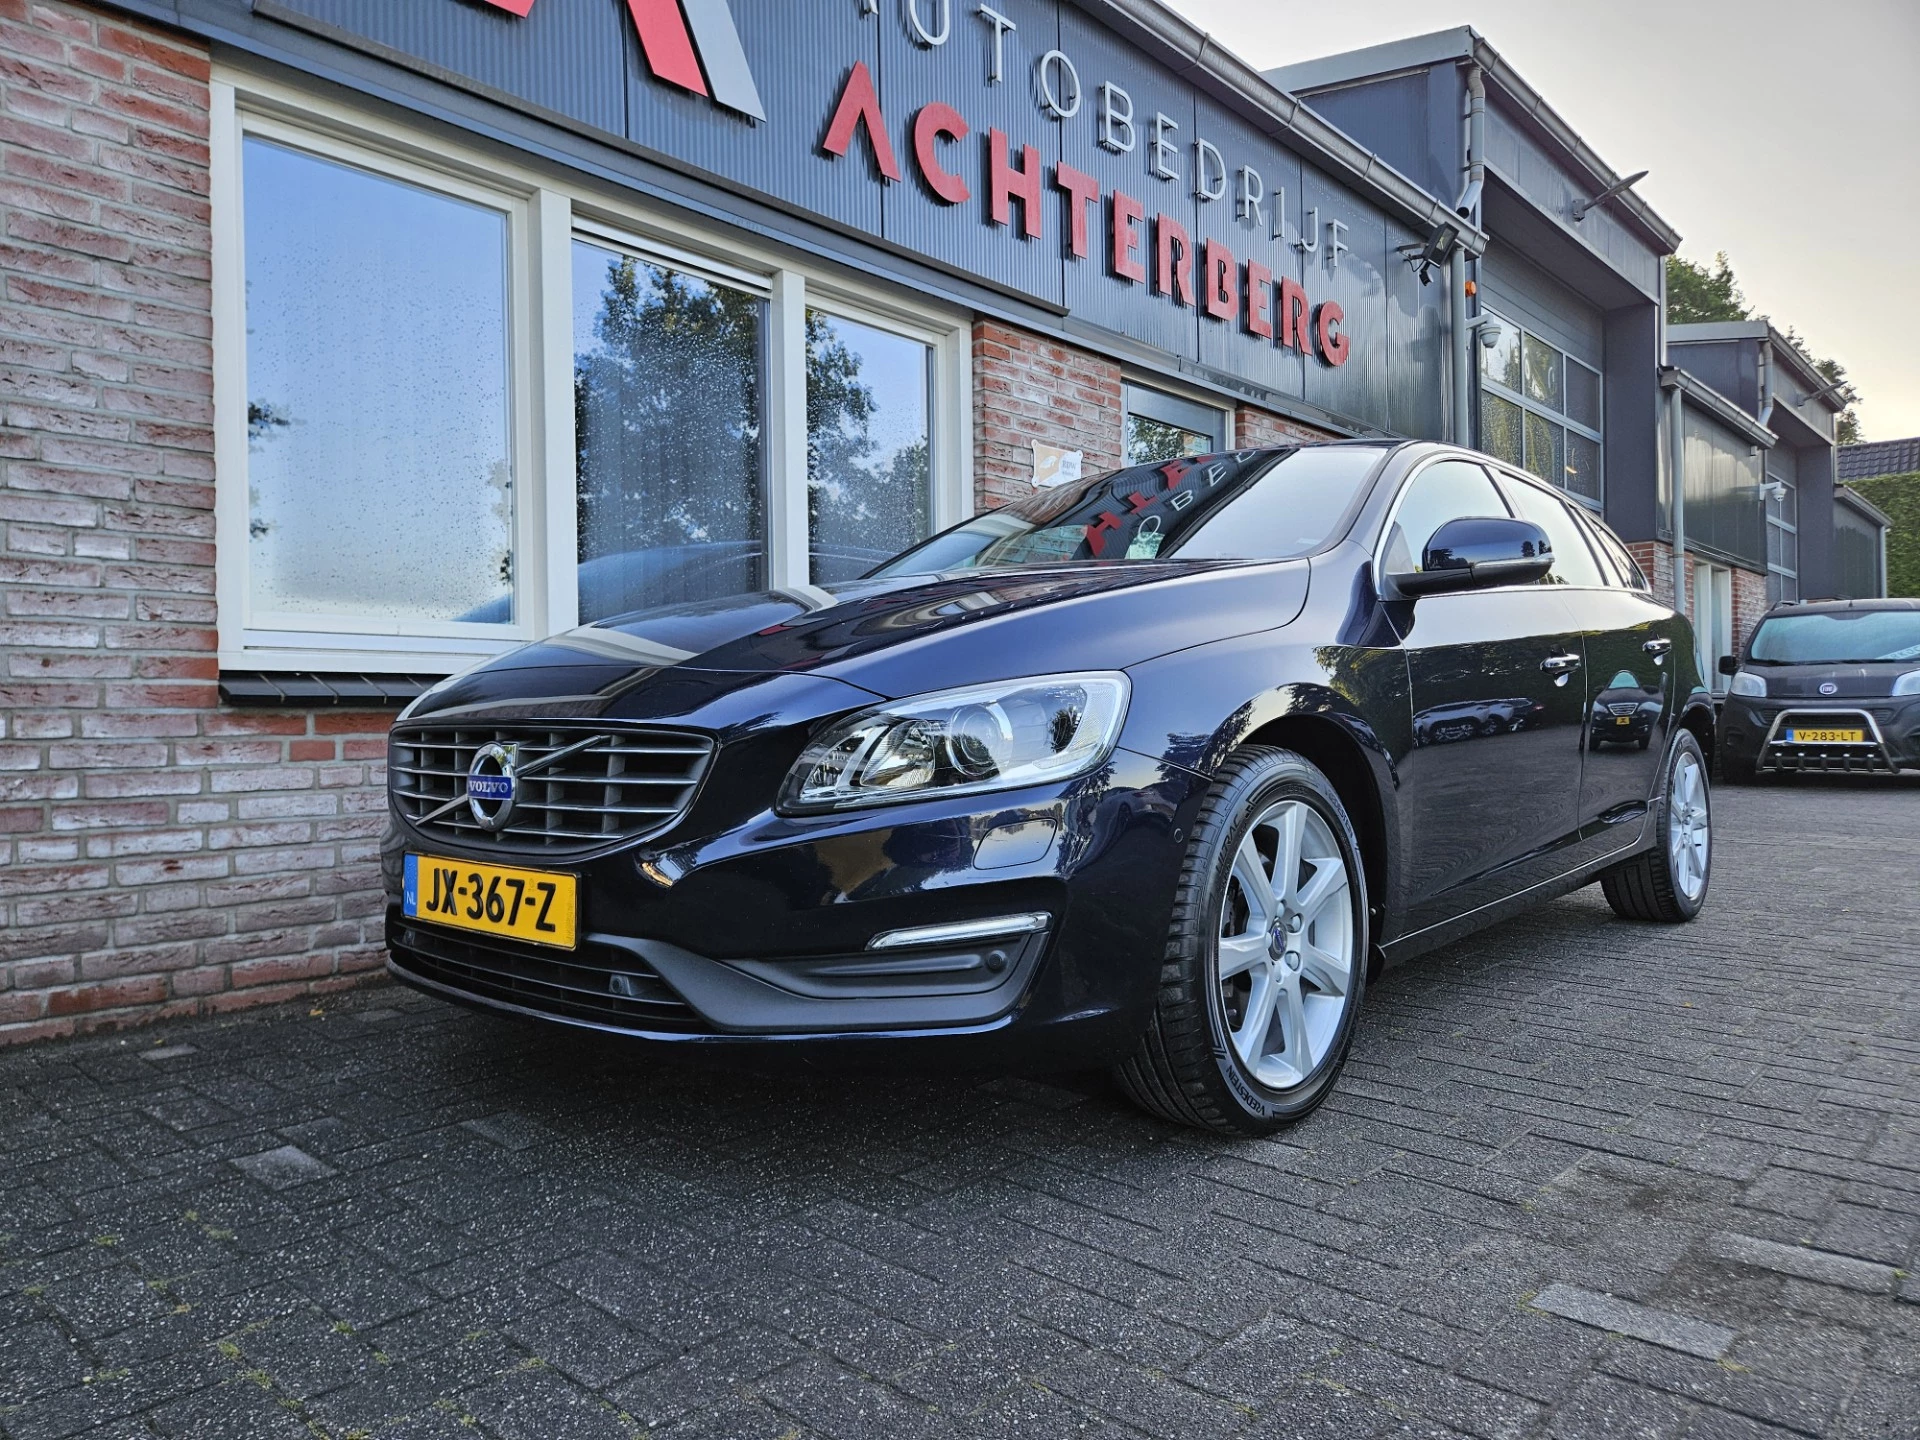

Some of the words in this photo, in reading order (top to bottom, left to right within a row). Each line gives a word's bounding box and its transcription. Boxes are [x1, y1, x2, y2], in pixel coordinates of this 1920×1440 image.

[867, 0, 1349, 268] UTOBEDRIJF
[822, 60, 1350, 367] ACHTERBERG
[1799, 731, 1856, 741] V-283-LT
[469, 779, 509, 794] VOLVO
[406, 891, 417, 906] NL
[425, 867, 556, 933] JX-367-Z
[1225, 1065, 1265, 1116] VREDESTEIN
